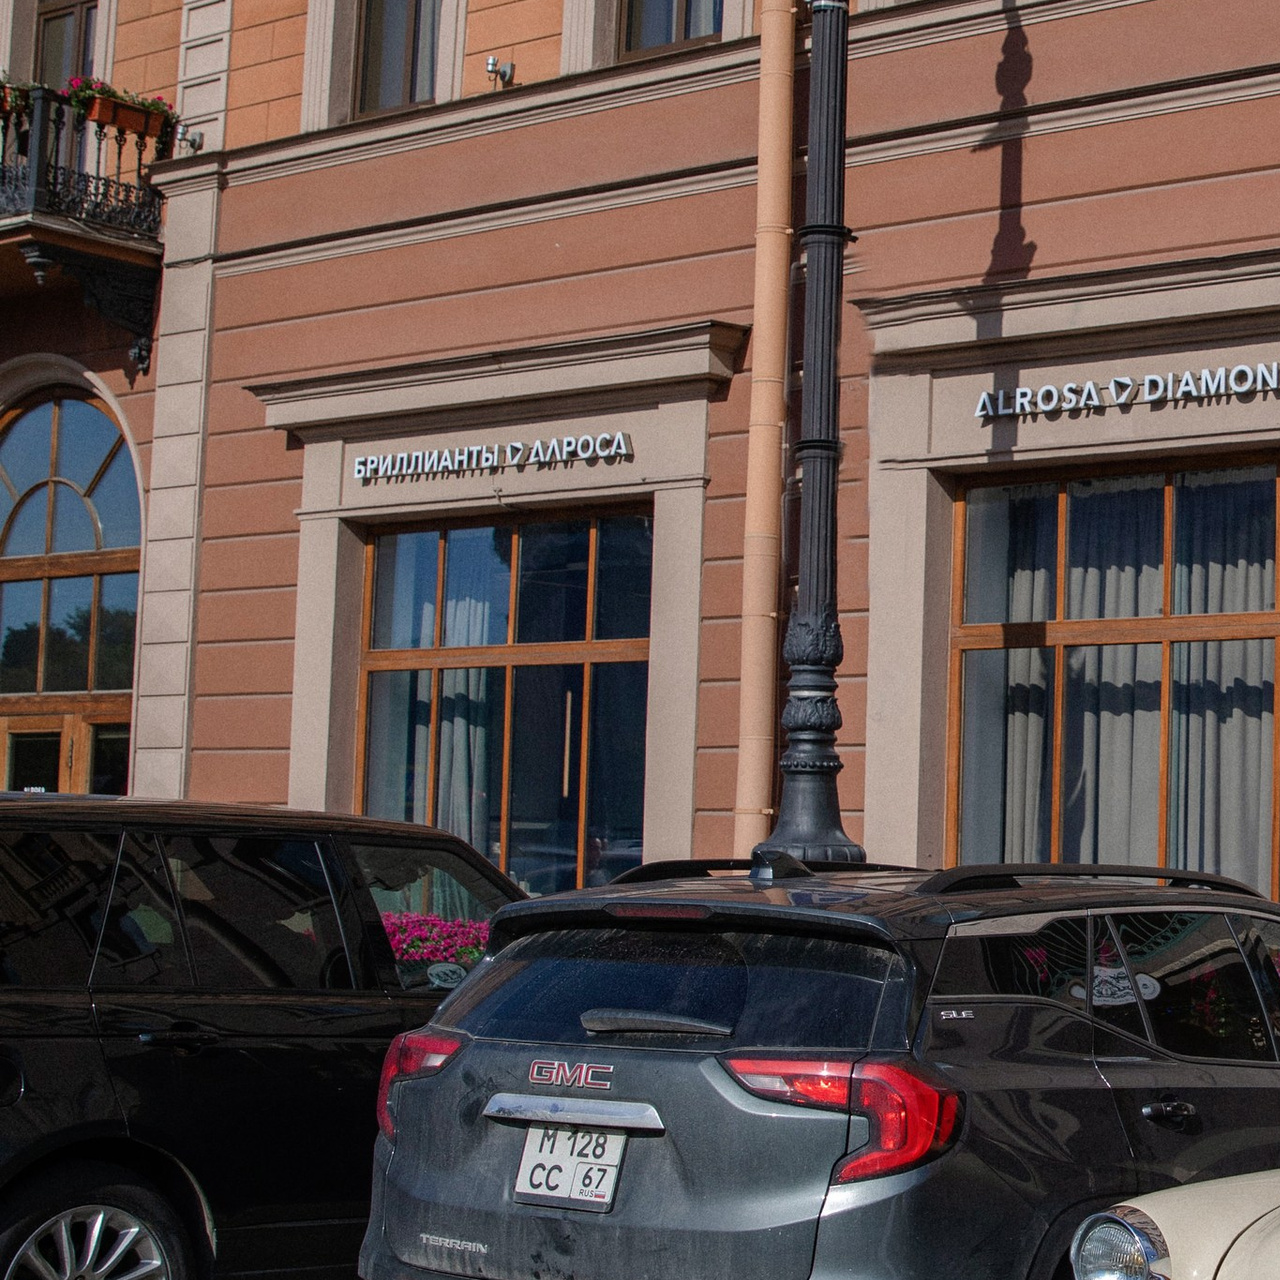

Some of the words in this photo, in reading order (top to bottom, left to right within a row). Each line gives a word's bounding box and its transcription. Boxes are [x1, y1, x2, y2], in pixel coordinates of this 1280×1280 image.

[975, 380, 1100, 417] ALROSA
[354, 443, 499, 479] БРИЛЛИАНТЫ
[528, 431, 628, 463] АЛРОСА
[940, 1010, 975, 1019] SLE
[528, 1059, 614, 1090] GMC
[567, 1128, 608, 1159] 128
[582, 1166, 608, 1190] 67
[579, 1188, 594, 1198] RUS
[420, 1233, 488, 1254] TERRAIN
